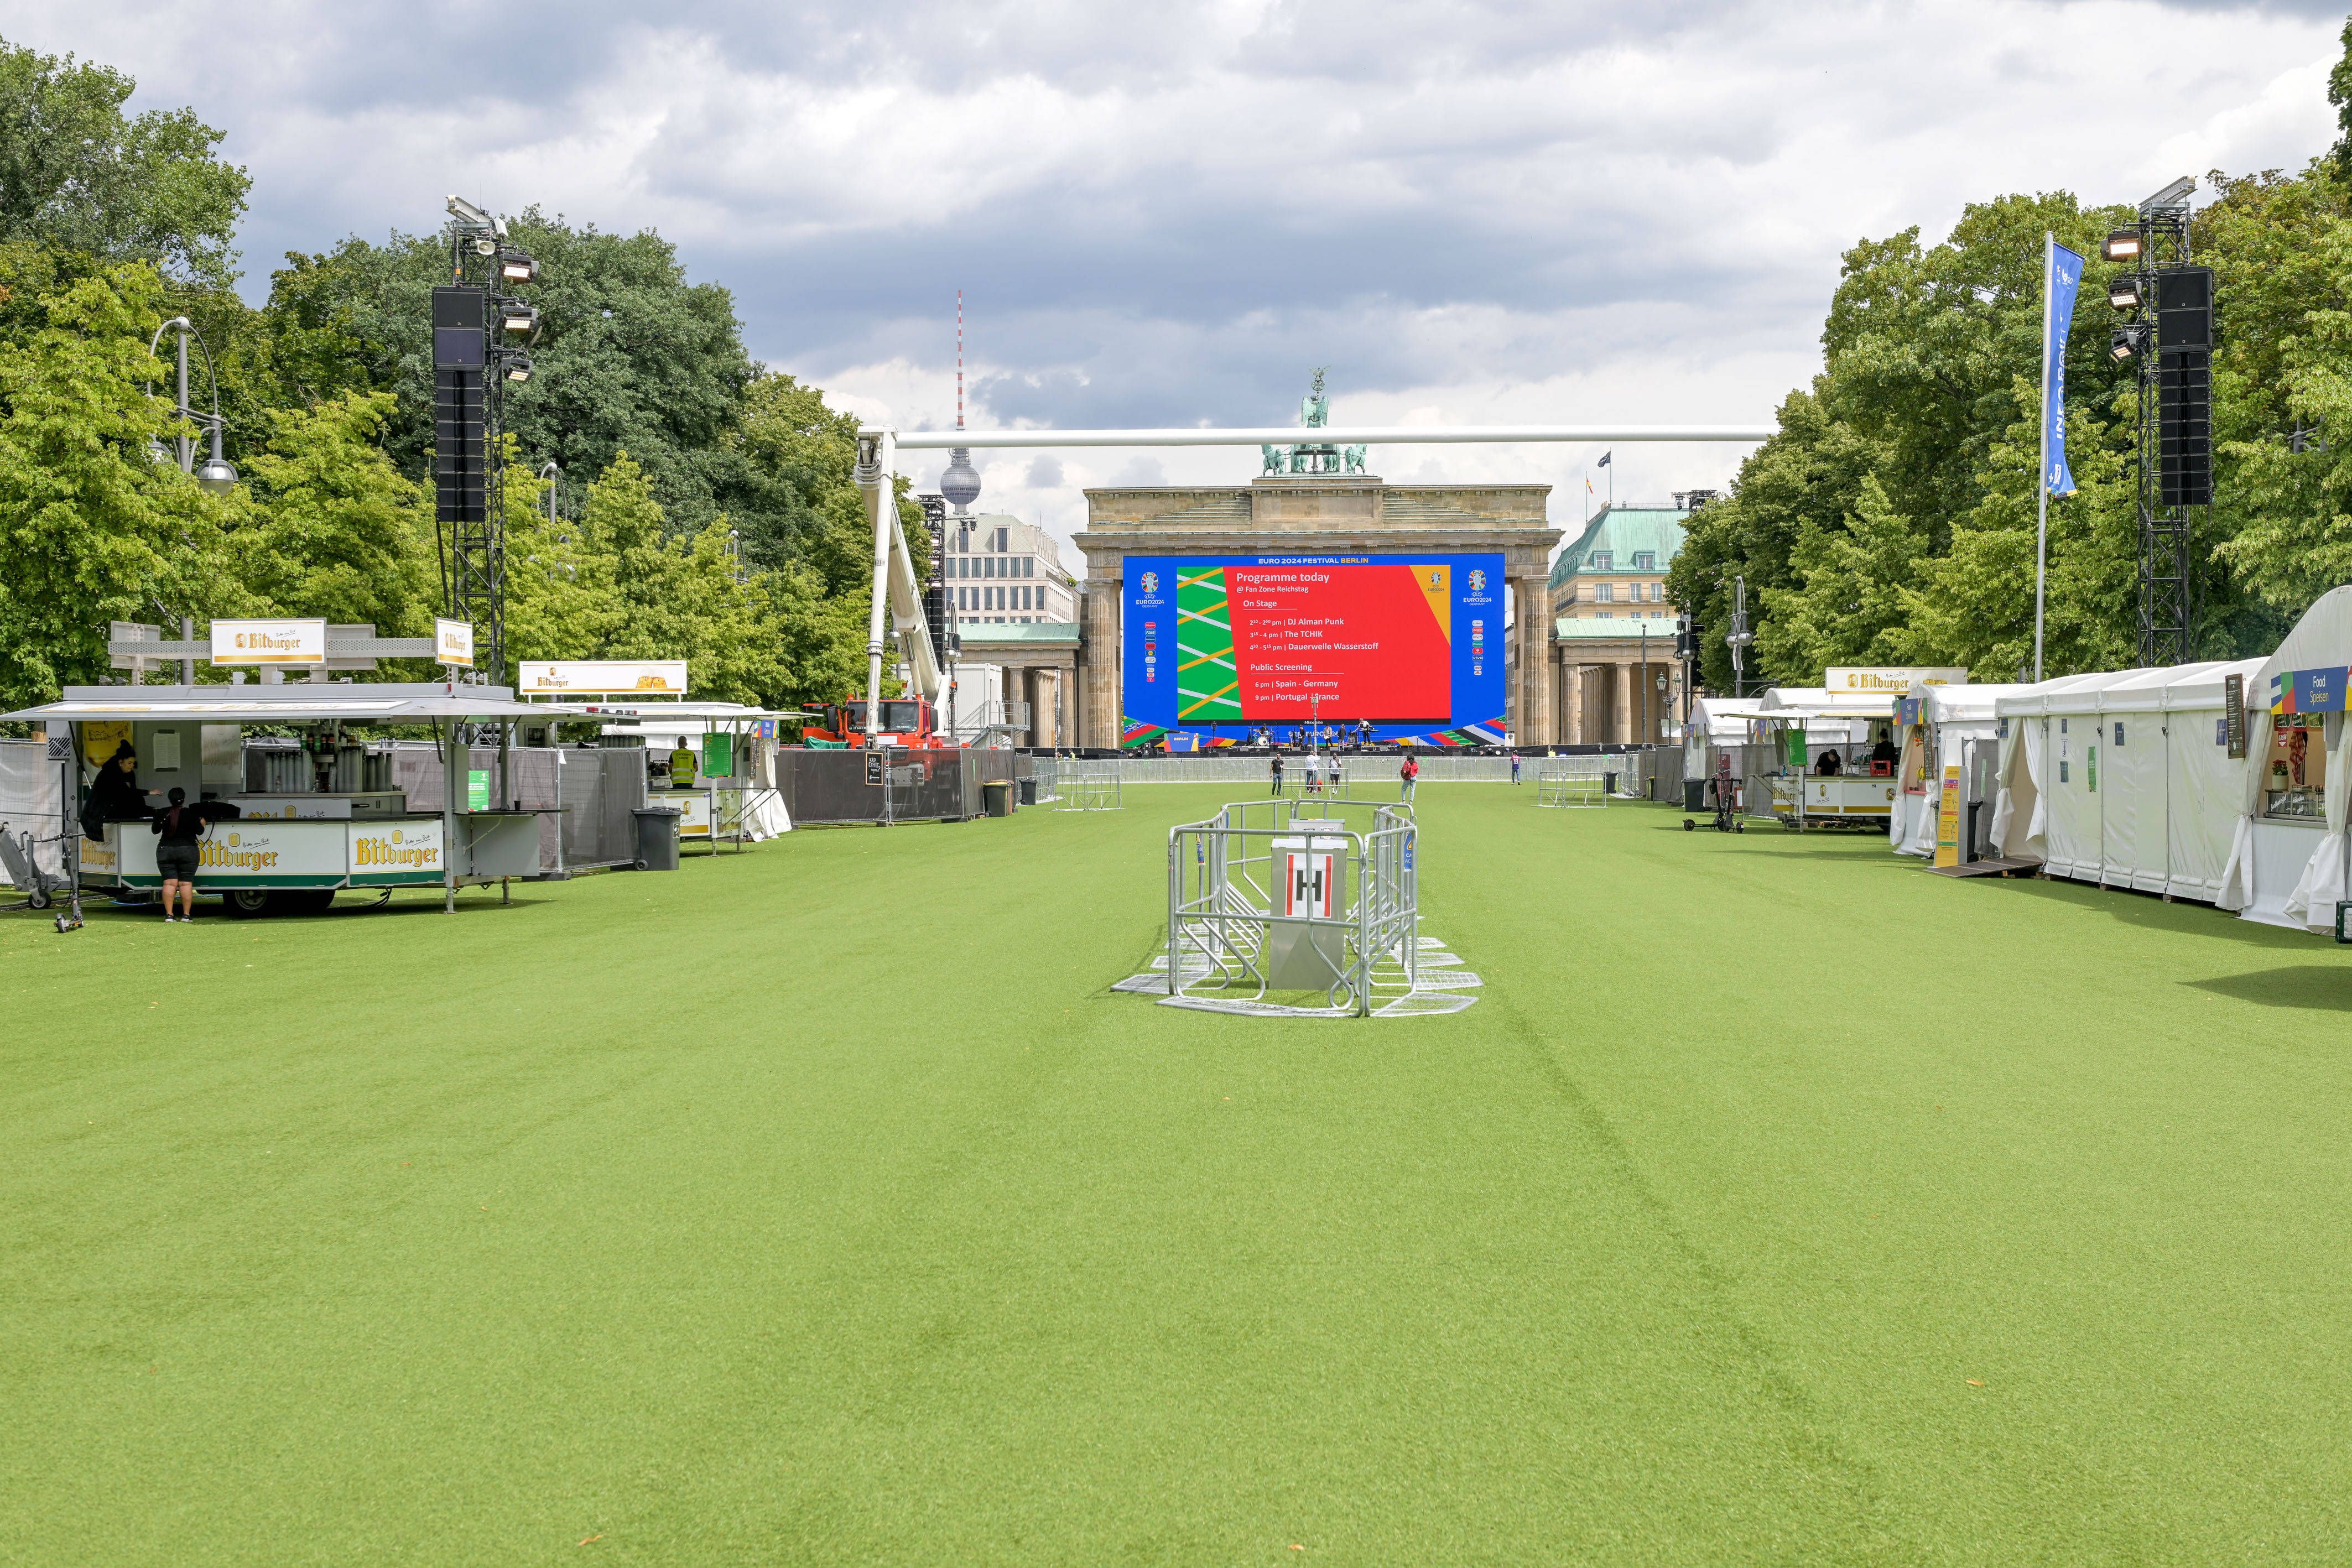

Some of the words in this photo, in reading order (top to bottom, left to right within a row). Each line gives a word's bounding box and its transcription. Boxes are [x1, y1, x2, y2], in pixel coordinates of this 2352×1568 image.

[1237, 573, 1297, 584] Programme
[1300, 572, 1329, 583] today
[248, 633, 300, 650] Bitburger
[537, 676, 569, 687] Bitburger
[1860, 674, 1909, 690] Bitburger
[2313, 675, 2326, 687] Food
[2309, 690, 2329, 706] Speisen
[355, 837, 439, 867] Bitburger
[1296, 870, 1322, 902] H
